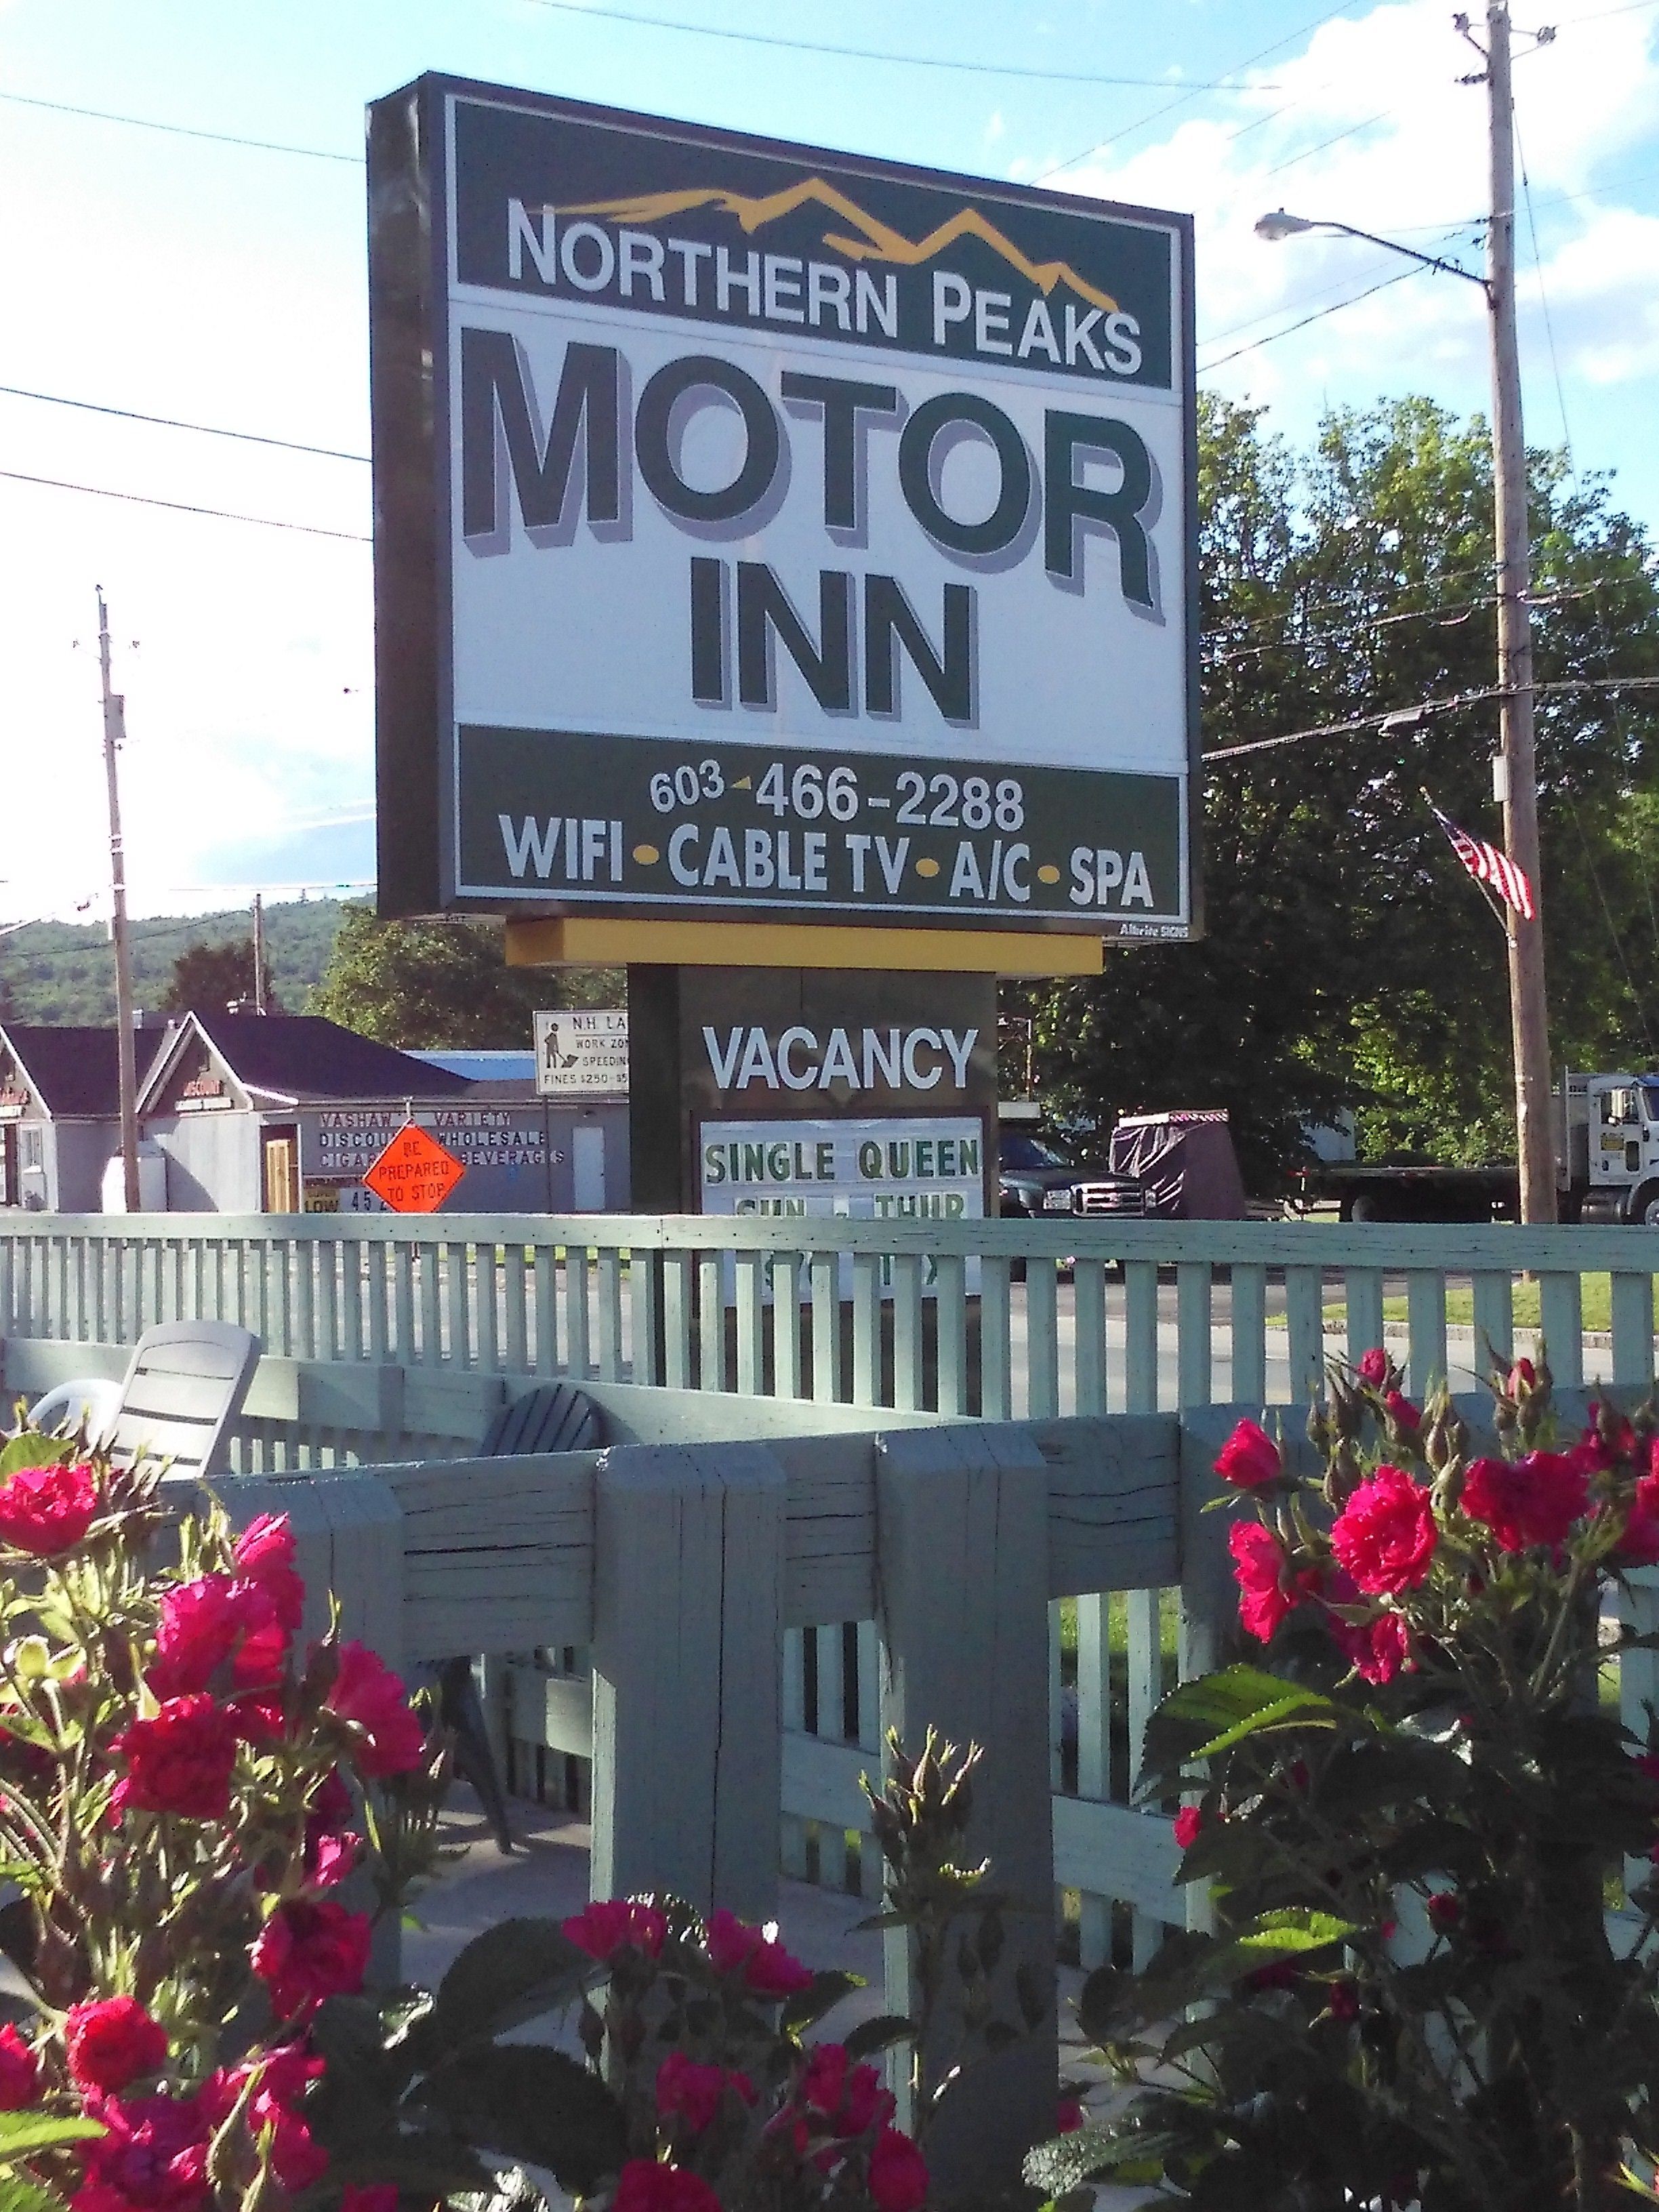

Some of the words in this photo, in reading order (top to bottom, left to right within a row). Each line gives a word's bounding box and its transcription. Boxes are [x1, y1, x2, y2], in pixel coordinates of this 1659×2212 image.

[508, 198, 898, 338] NORTHERN
[933, 270, 1143, 375] PEAKS
[461, 327, 1165, 626] MOTOR
[691, 556, 979, 729] INN
[649, 759, 725, 813] 603
[756, 762, 1025, 832] 466-2288
[498, 814, 623, 881] WIFI
[668, 823, 827, 890] CABLE
[845, 834, 910, 895] TV
[949, 839, 1031, 903] A/C
[1069, 846, 1154, 908] SPA
[607, 1016, 626, 1029] LA
[576, 1039, 605, 1049] WORK
[582, 1056, 627, 1067] SPEEDIN
[702, 1026, 979, 1090] VACANCY
[544, 1074, 577, 1084] FINES
[434, 1111, 511, 1127] VARIETY
[320, 1132, 396, 1147] DISCOU
[403, 1141, 422, 1158] BE
[461, 1151, 565, 1166] BEVERAGS
[379, 1160, 449, 1181] PREPARED
[705, 1143, 836, 1183] SINGLE
[859, 1139, 979, 1179] QUEEN
[387, 1186, 404, 1202] TO
[411, 1183, 445, 1200] STOP
